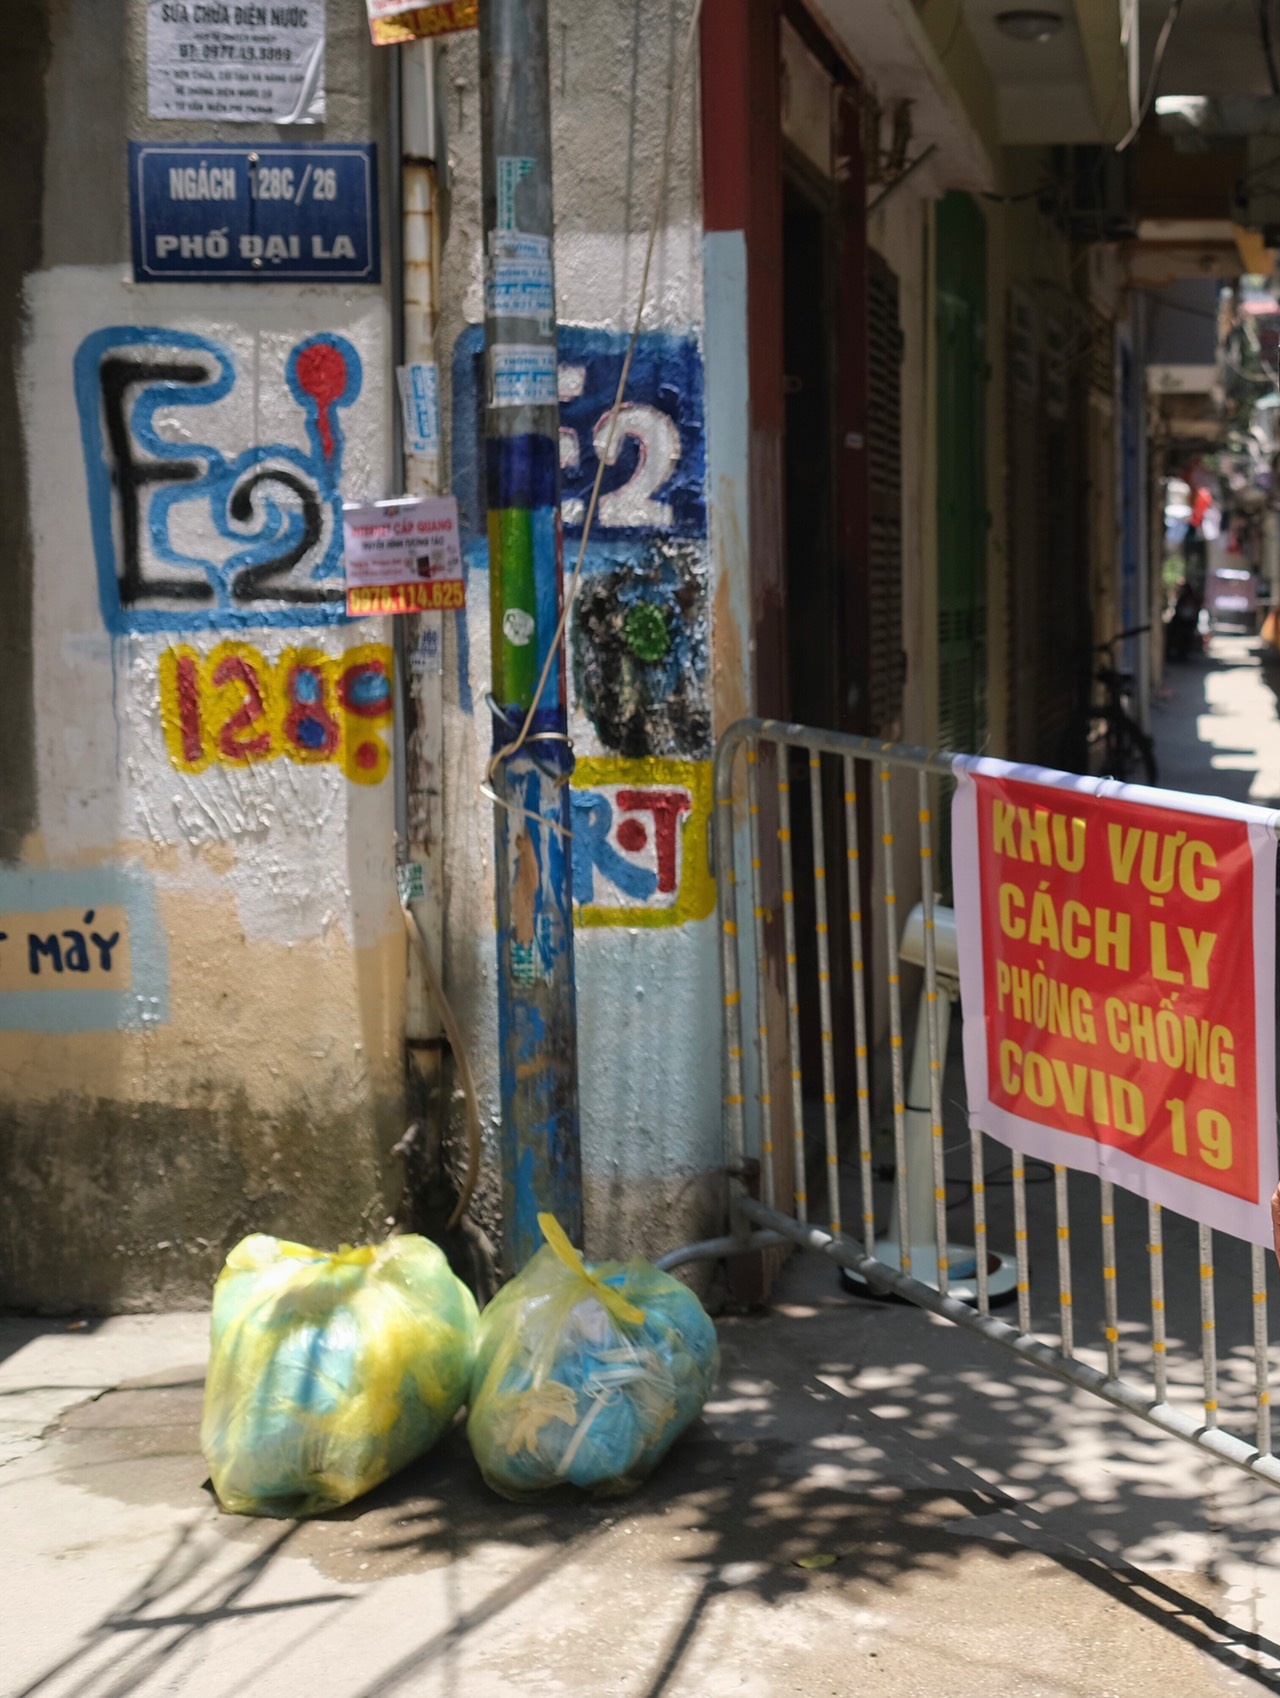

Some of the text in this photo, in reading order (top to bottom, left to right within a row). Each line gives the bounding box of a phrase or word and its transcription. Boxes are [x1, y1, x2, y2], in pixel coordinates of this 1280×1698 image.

[168, 160, 337, 206] NGÁCH 128C/26
[155, 226, 356, 264] PHỐ ĐẠI LA
[100, 358, 347, 607] E2
[992, 799, 1222, 907] KHU VỰC
[998, 880, 1217, 989] CÁCH LY
[996, 957, 1236, 1088] PHÒNG CHỐNG
[999, 1038, 1233, 1170] COVID 19
